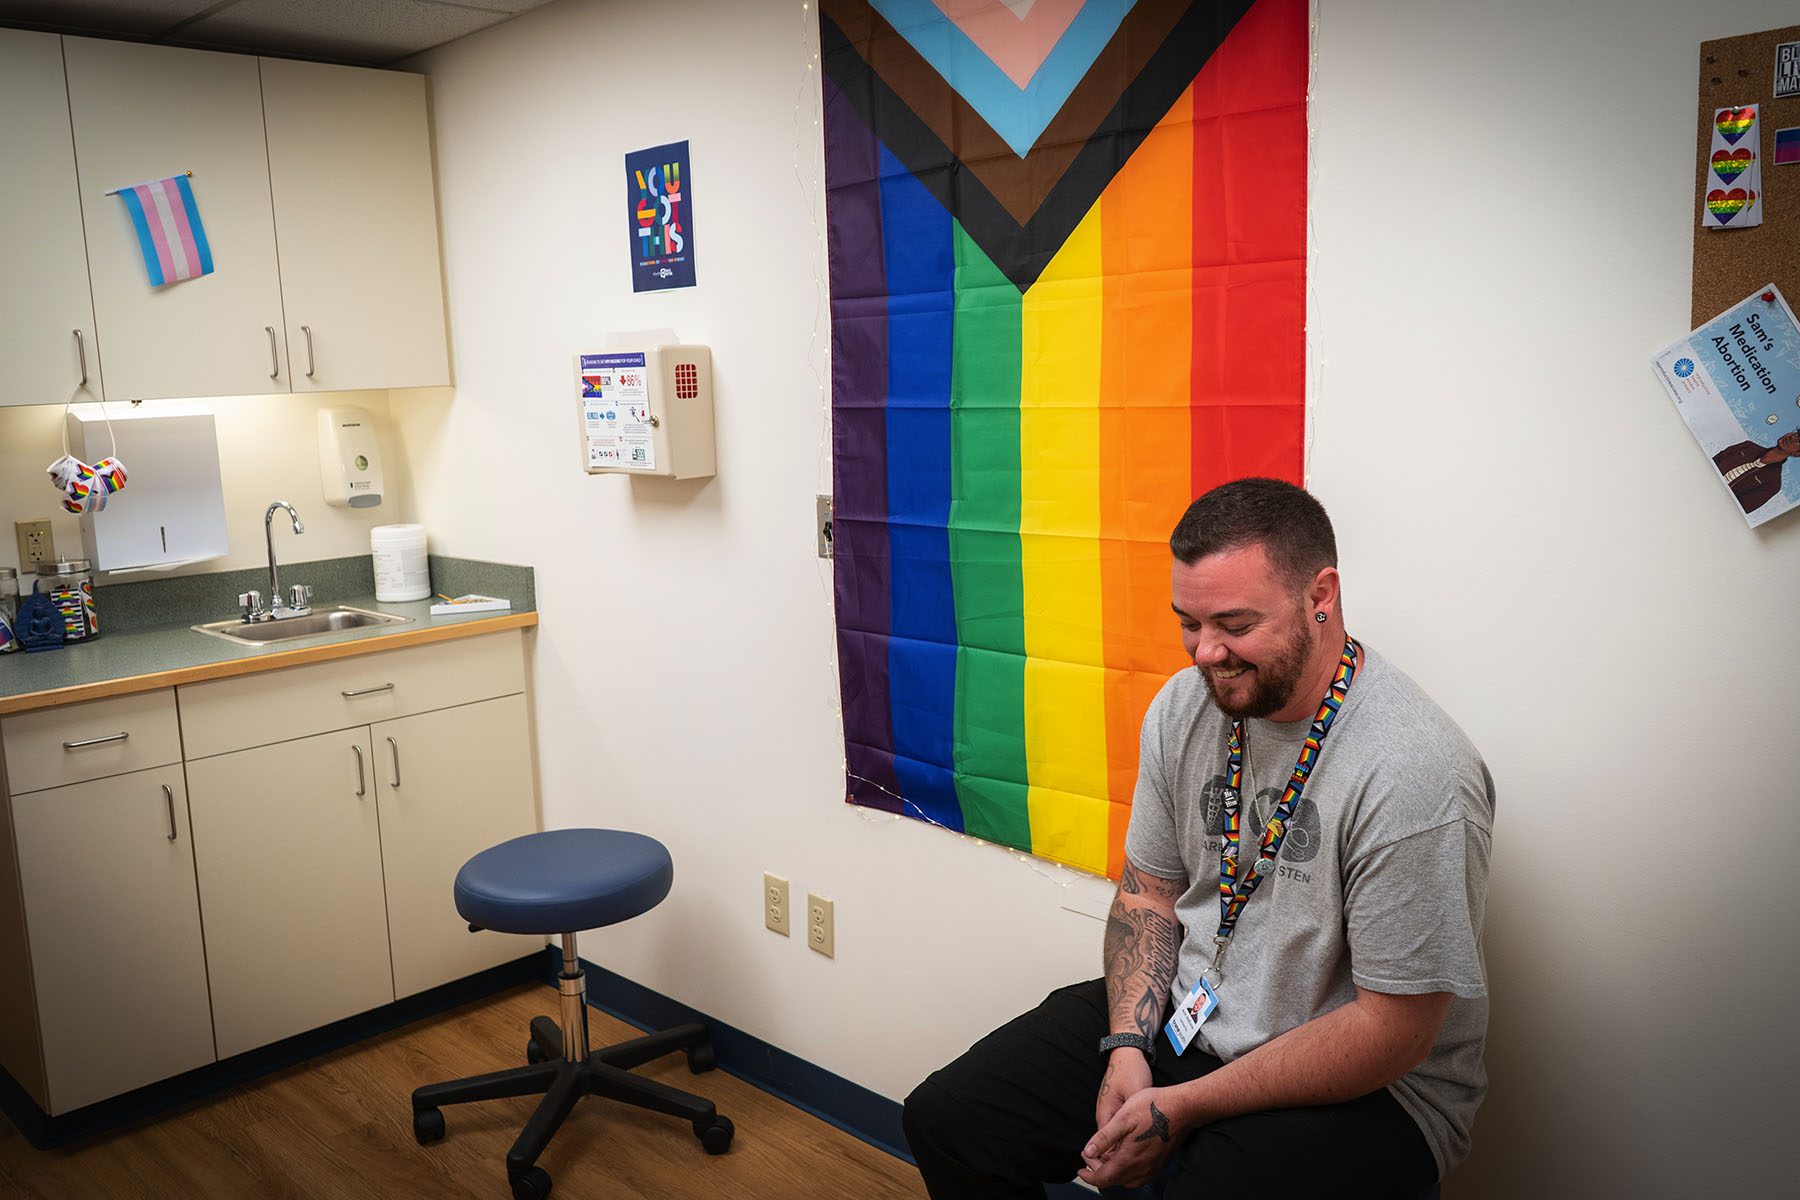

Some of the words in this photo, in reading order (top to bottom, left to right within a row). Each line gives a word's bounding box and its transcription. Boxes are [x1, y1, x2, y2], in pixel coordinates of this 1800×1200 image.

[1781, 46, 1800, 61] BL
[1780, 76, 1800, 92] MA
[635, 162, 680, 199] YOU
[637, 192, 681, 227] GOT
[638, 223, 684, 257] THIS
[1746, 313, 1774, 351] Sam's
[1711, 336, 1751, 392] Abortion
[1729, 323, 1777, 394] Medication
[626, 374, 642, 386] 86%
[1278, 865, 1312, 884] STEN
